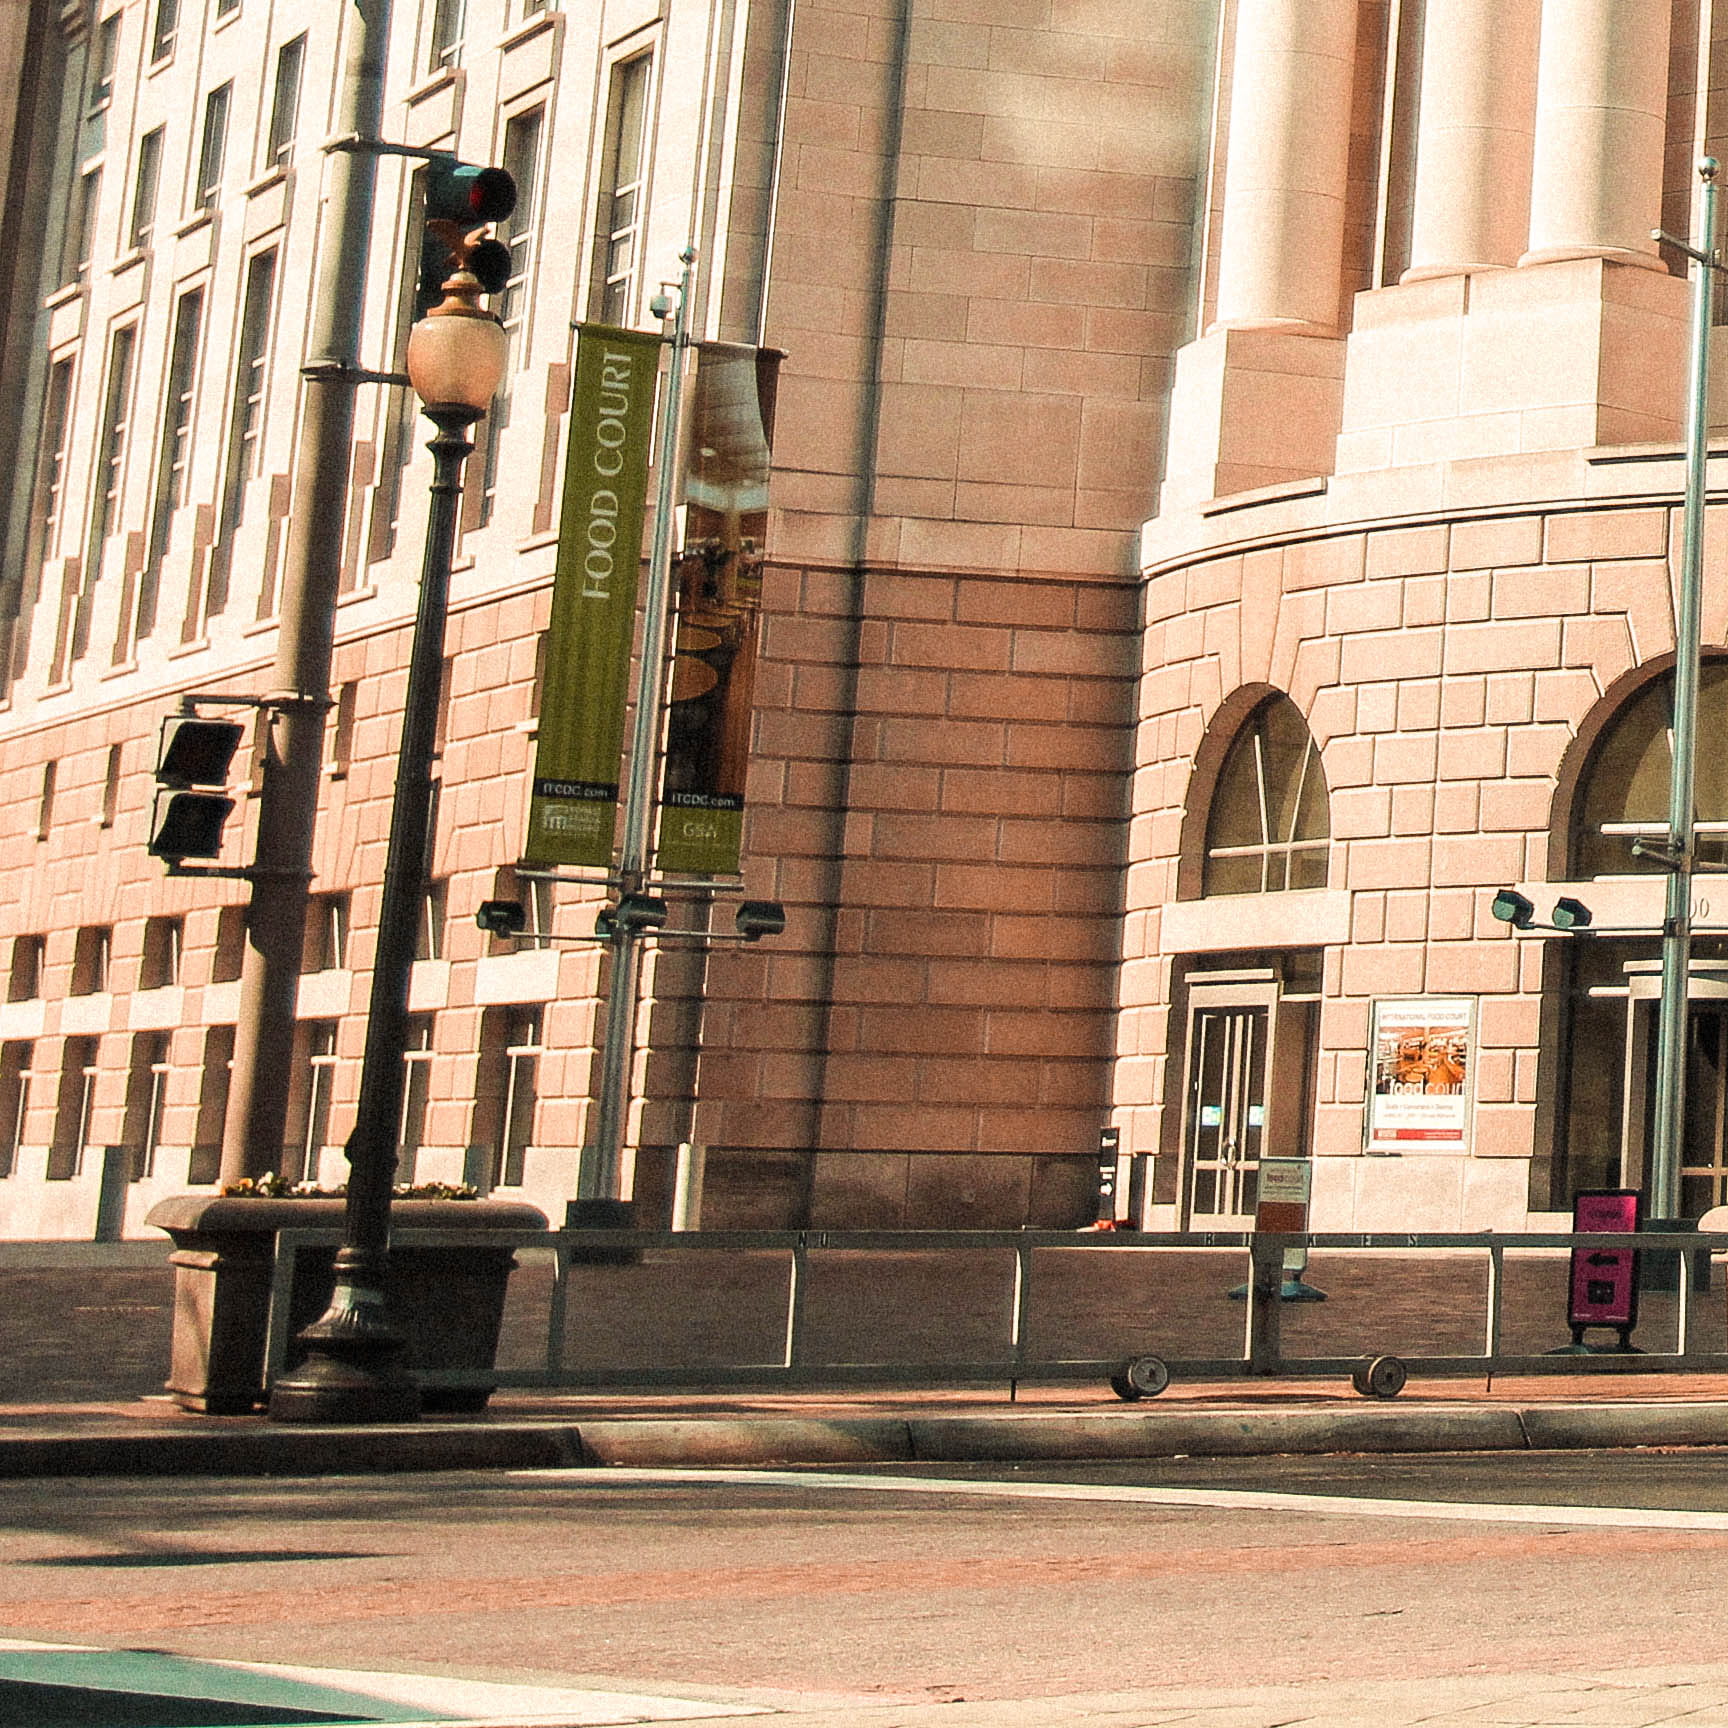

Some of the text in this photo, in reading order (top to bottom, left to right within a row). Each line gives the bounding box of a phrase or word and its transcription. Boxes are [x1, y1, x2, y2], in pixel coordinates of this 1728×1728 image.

[582, 349, 632, 600] FOOD COURT
[672, 792, 735, 807] ITCDC.com
